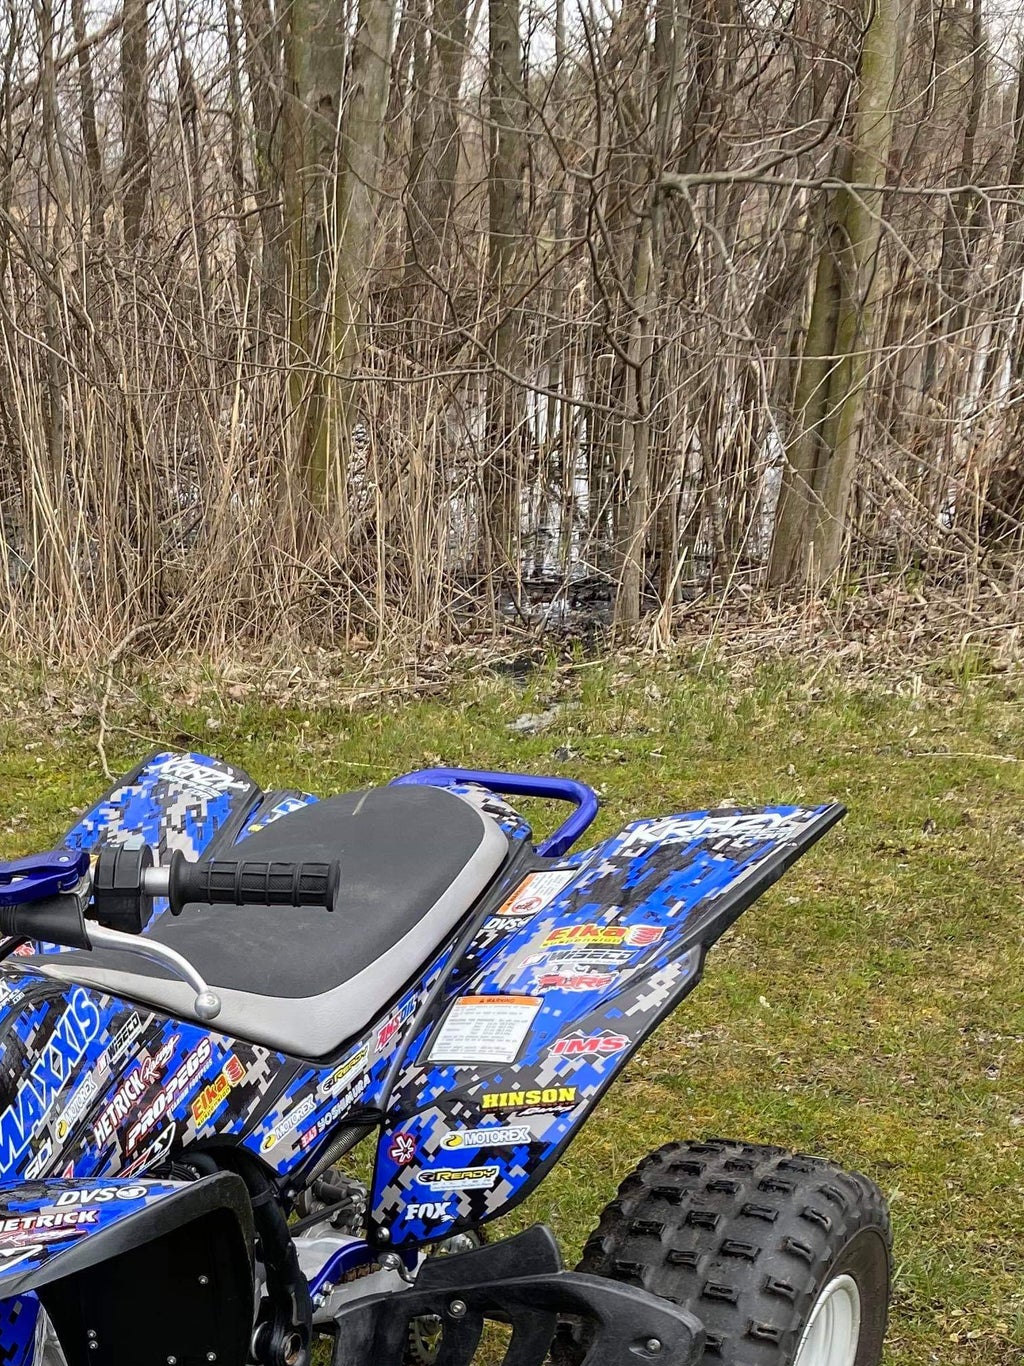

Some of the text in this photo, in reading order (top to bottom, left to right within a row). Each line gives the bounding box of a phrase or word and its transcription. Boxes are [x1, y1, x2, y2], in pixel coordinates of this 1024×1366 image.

[622, 811, 805, 846] KRAZY
[484, 917, 522, 931] DVS
[377, 996, 417, 1047] AMSOIL
[553, 1036, 627, 1054] IMS
[66, 1074, 96, 1126] MOTOREX
[482, 1087, 576, 1108] HINSON
[93, 1069, 145, 1149] HETRICK
[275, 1098, 316, 1140] MOTOREX
[464, 1128, 529, 1146] MOTOREX
[53, 1189, 116, 1208] DVS
[405, 1202, 452, 1221] FOX
